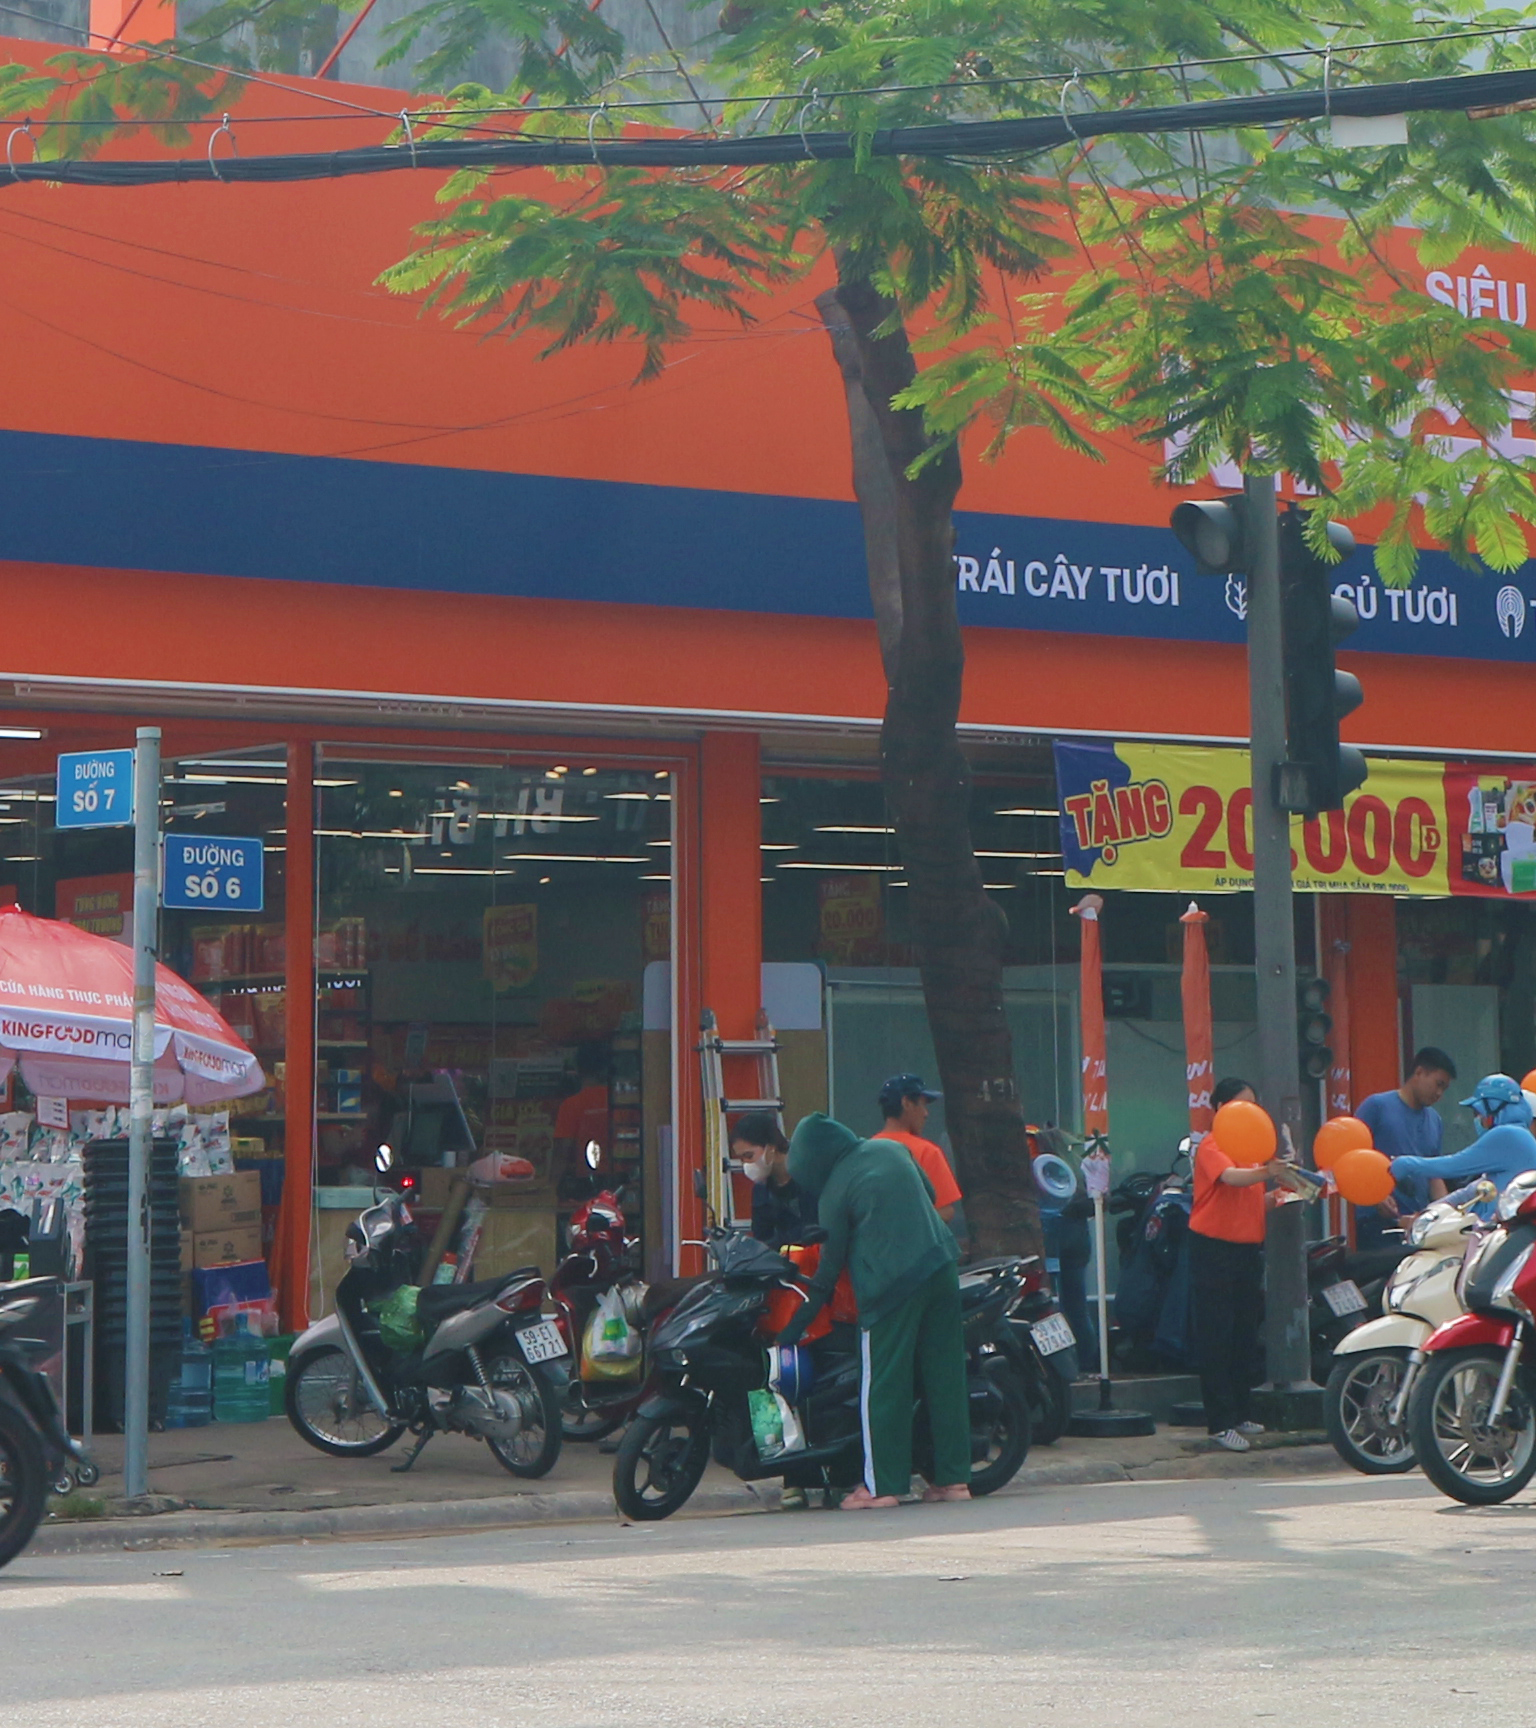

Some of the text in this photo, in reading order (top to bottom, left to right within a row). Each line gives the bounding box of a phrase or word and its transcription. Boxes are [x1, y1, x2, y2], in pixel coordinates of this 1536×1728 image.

[1425, 264, 1528, 326] SIÊU
[1025, 554, 1092, 598] CÂY
[1101, 564, 1181, 607] TƯƠI
[1384, 584, 1458, 626] TƯƠI
[75, 759, 115, 780] ĐƯỜNG
[73, 780, 116, 812] SỐ 7
[1064, 778, 1174, 866] TẶNG
[182, 843, 245, 866] ĐƯỜNG
[184, 867, 241, 899] SỐ 6
[28, 982, 64, 999] HÀNG
[67, 988, 102, 1005] THỰC
